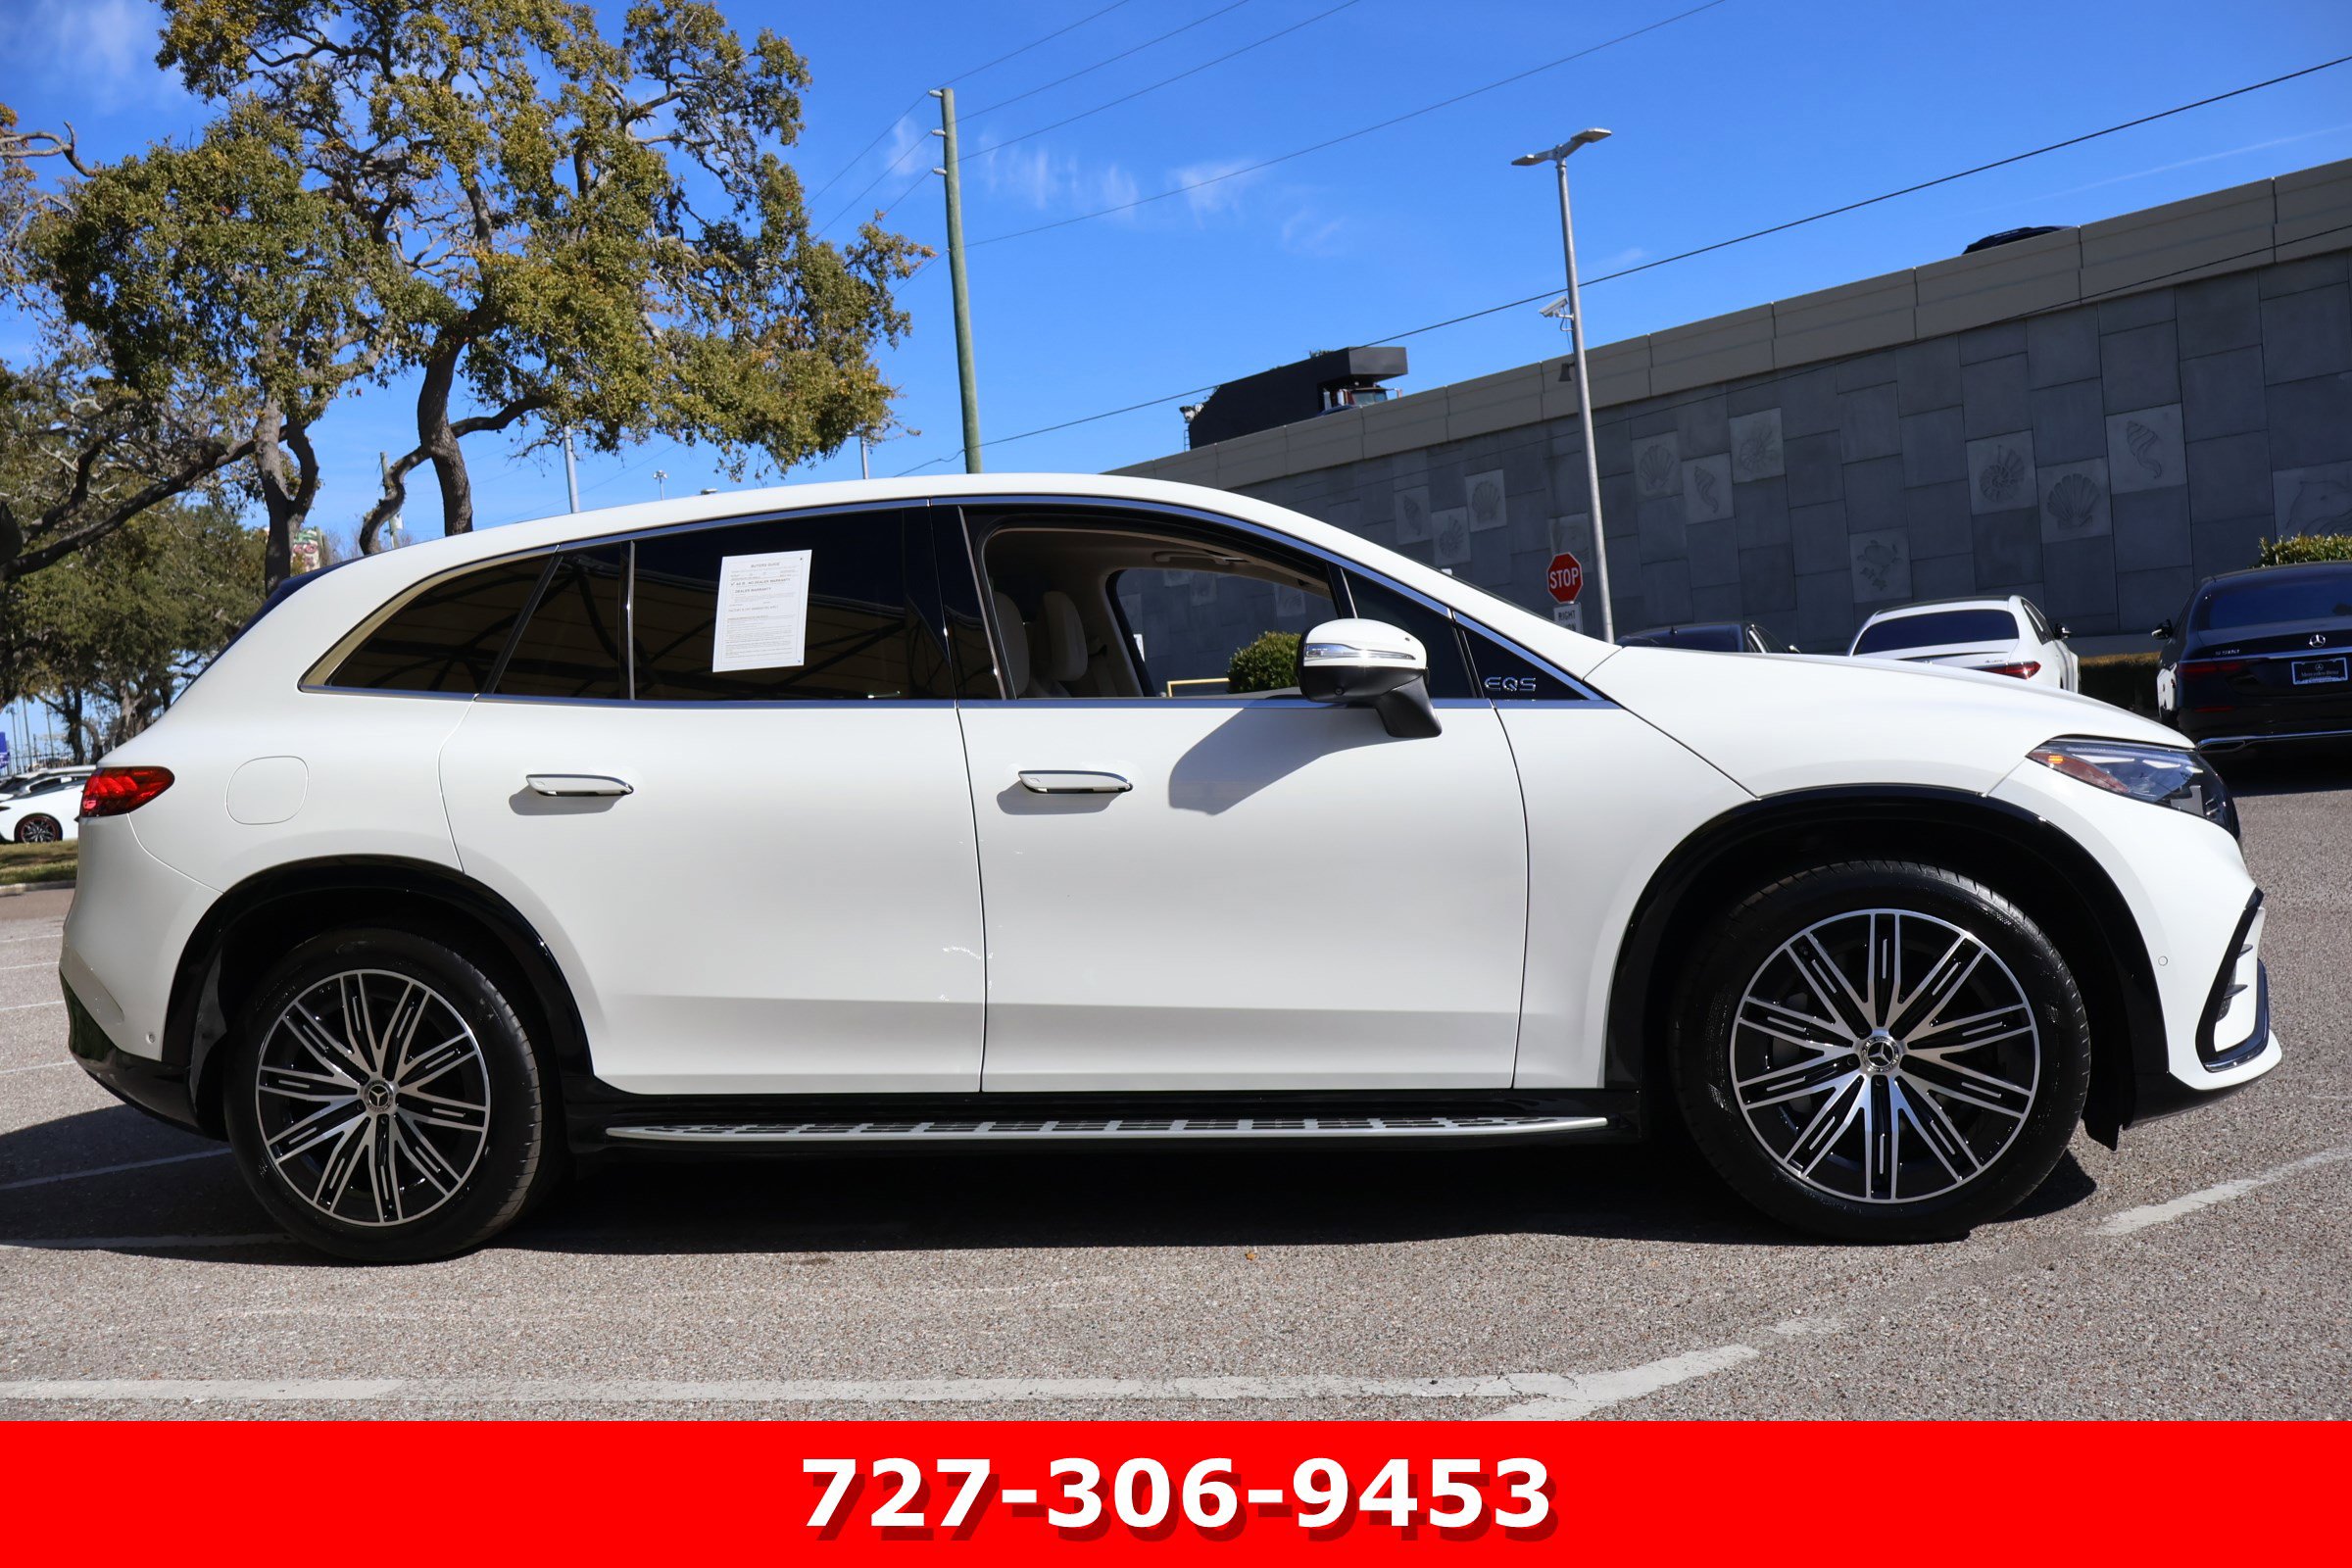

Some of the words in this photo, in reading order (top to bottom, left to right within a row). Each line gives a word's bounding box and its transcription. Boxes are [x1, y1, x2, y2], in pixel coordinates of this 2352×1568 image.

[1549, 567, 1579, 589] STOP
[1558, 610, 1576, 621] RIGHT
[1484, 676, 1537, 691] EQS
